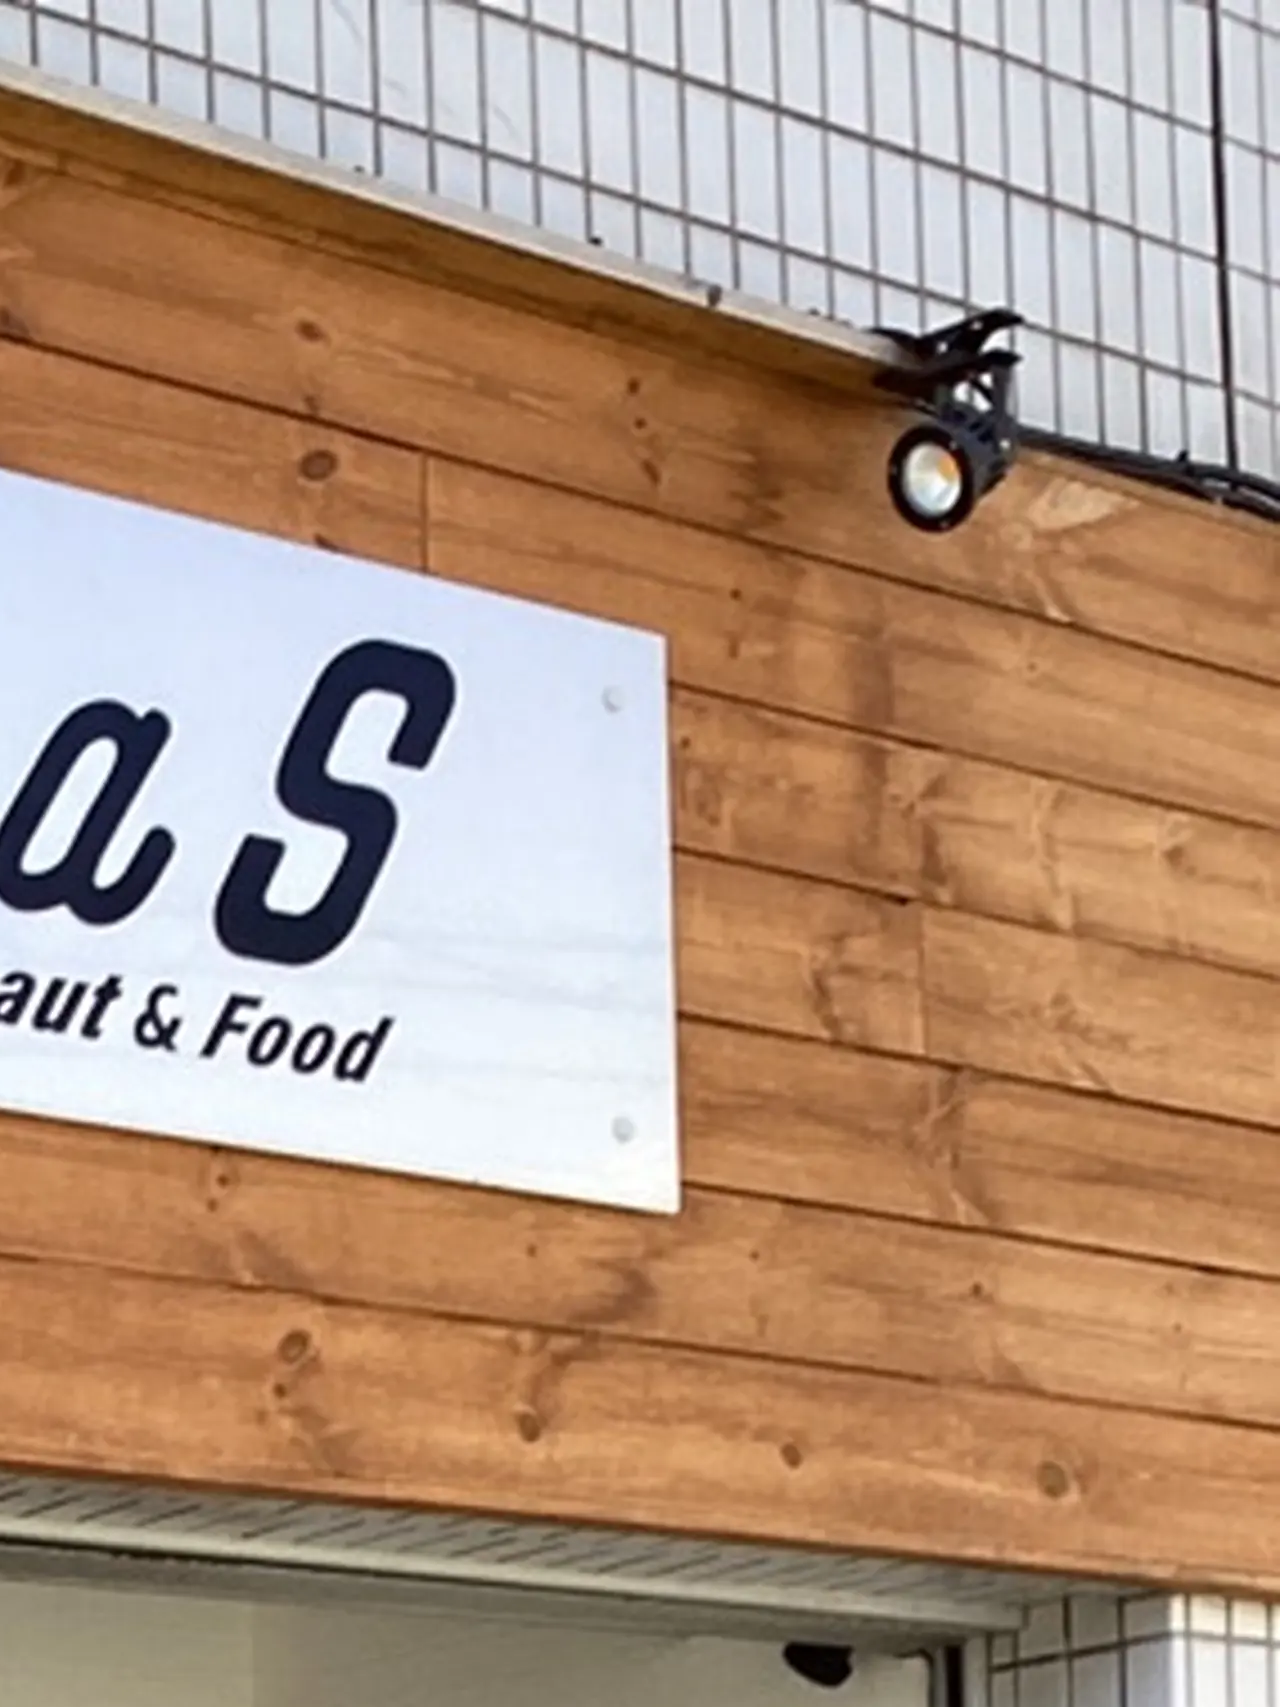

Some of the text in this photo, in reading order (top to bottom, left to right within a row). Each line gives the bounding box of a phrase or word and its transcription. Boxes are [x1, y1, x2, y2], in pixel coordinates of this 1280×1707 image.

[213, 636, 457, 968] S
[132, 982, 182, 1050] &
[199, 997, 394, 1087] Food
